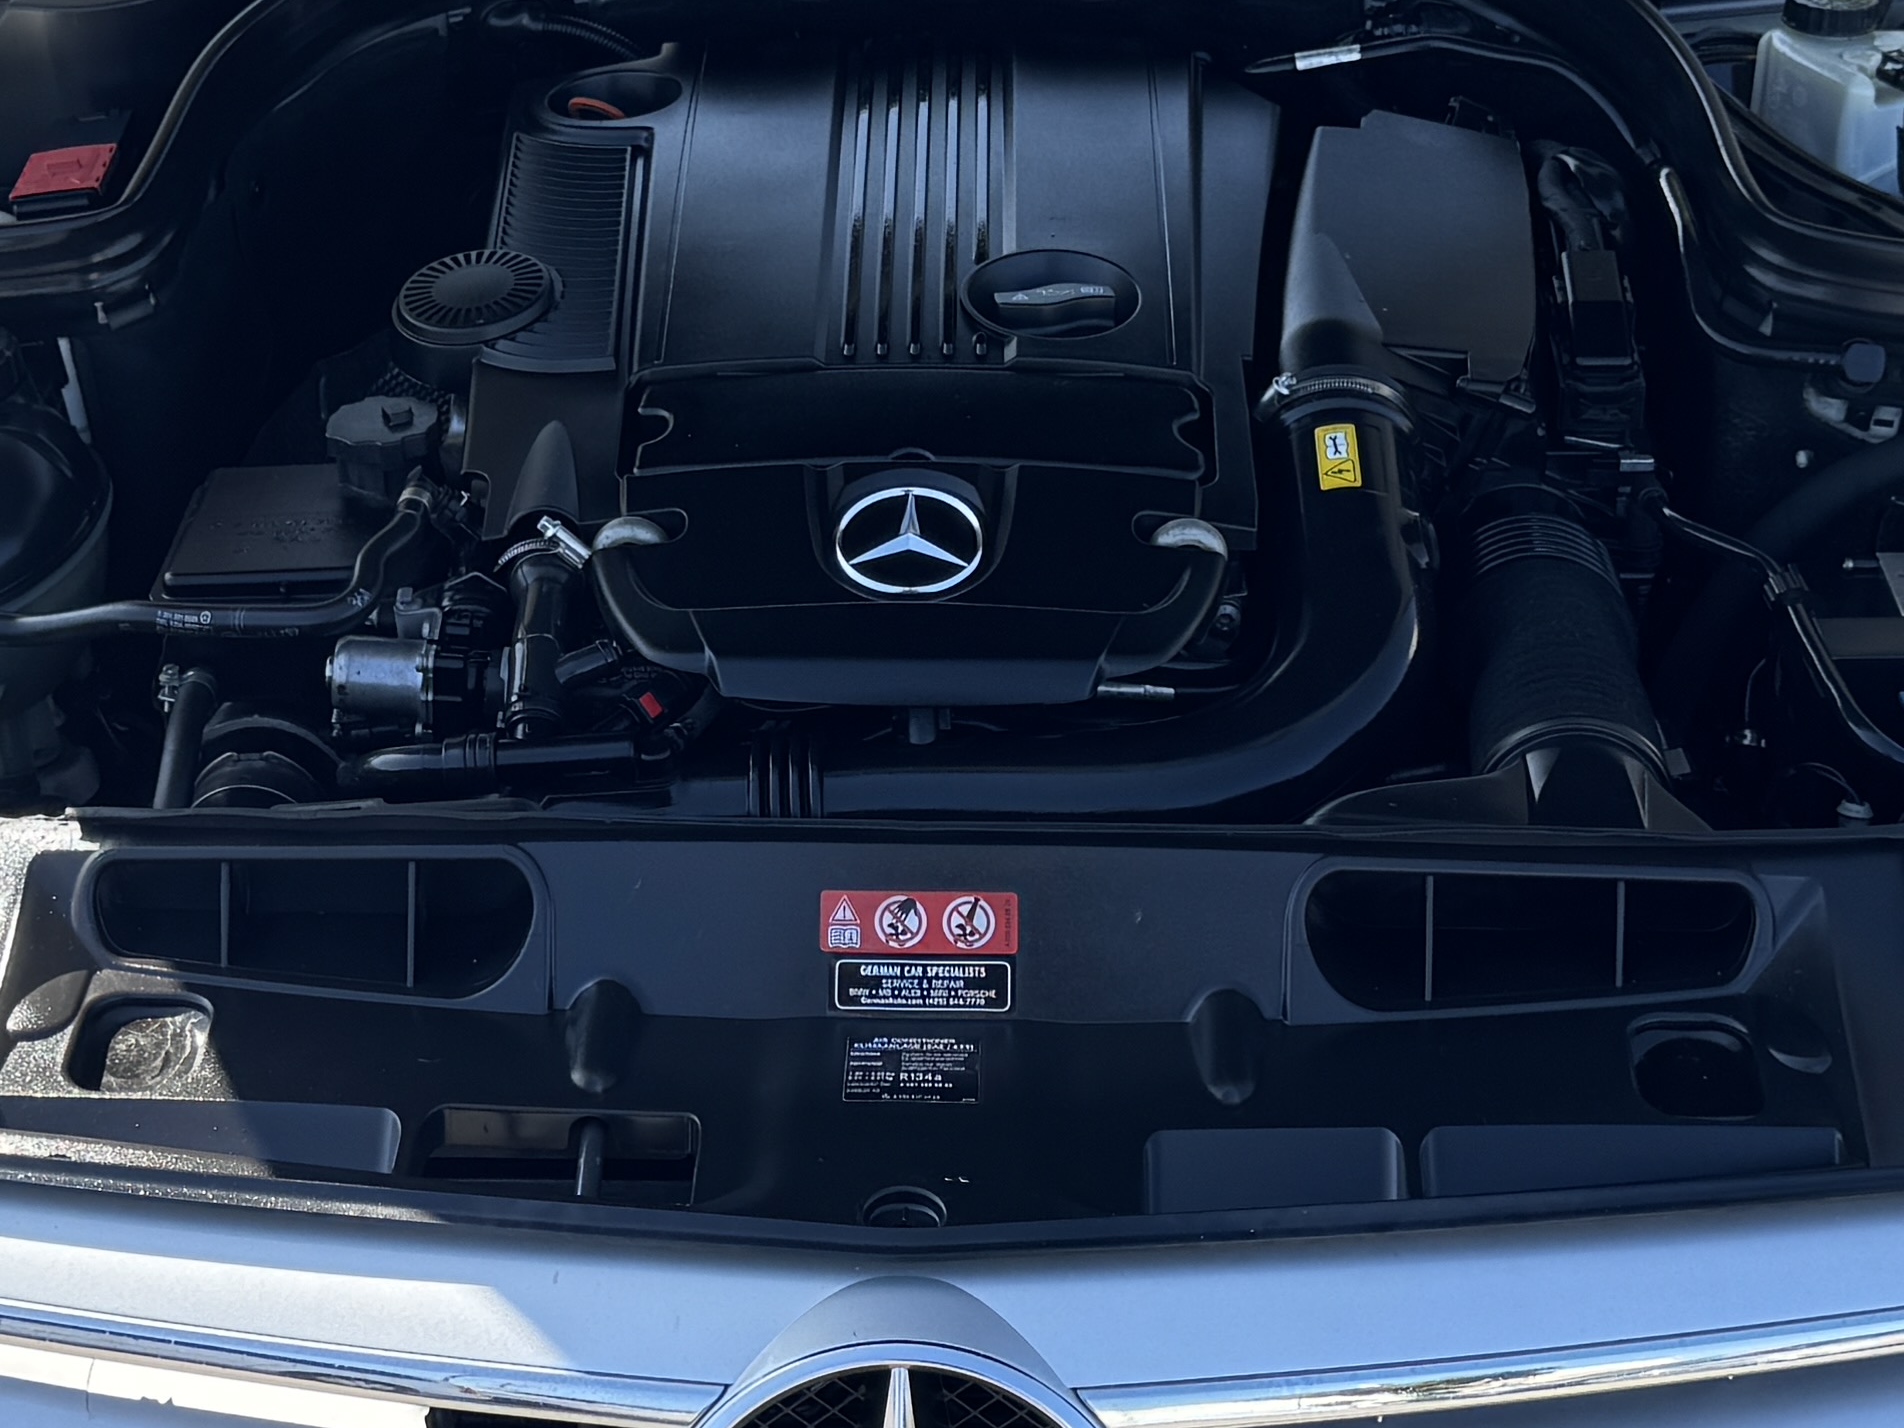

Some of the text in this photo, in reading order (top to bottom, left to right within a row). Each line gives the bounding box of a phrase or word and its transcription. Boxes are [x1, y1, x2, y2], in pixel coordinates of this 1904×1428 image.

[860, 964, 986, 978] GERMAN CAR SPECIALISTS
[881, 978, 964, 989] SERVICE & REPAIR
[957, 989, 997, 998] PORSCHE
[899, 1072, 942, 1081] R134a
